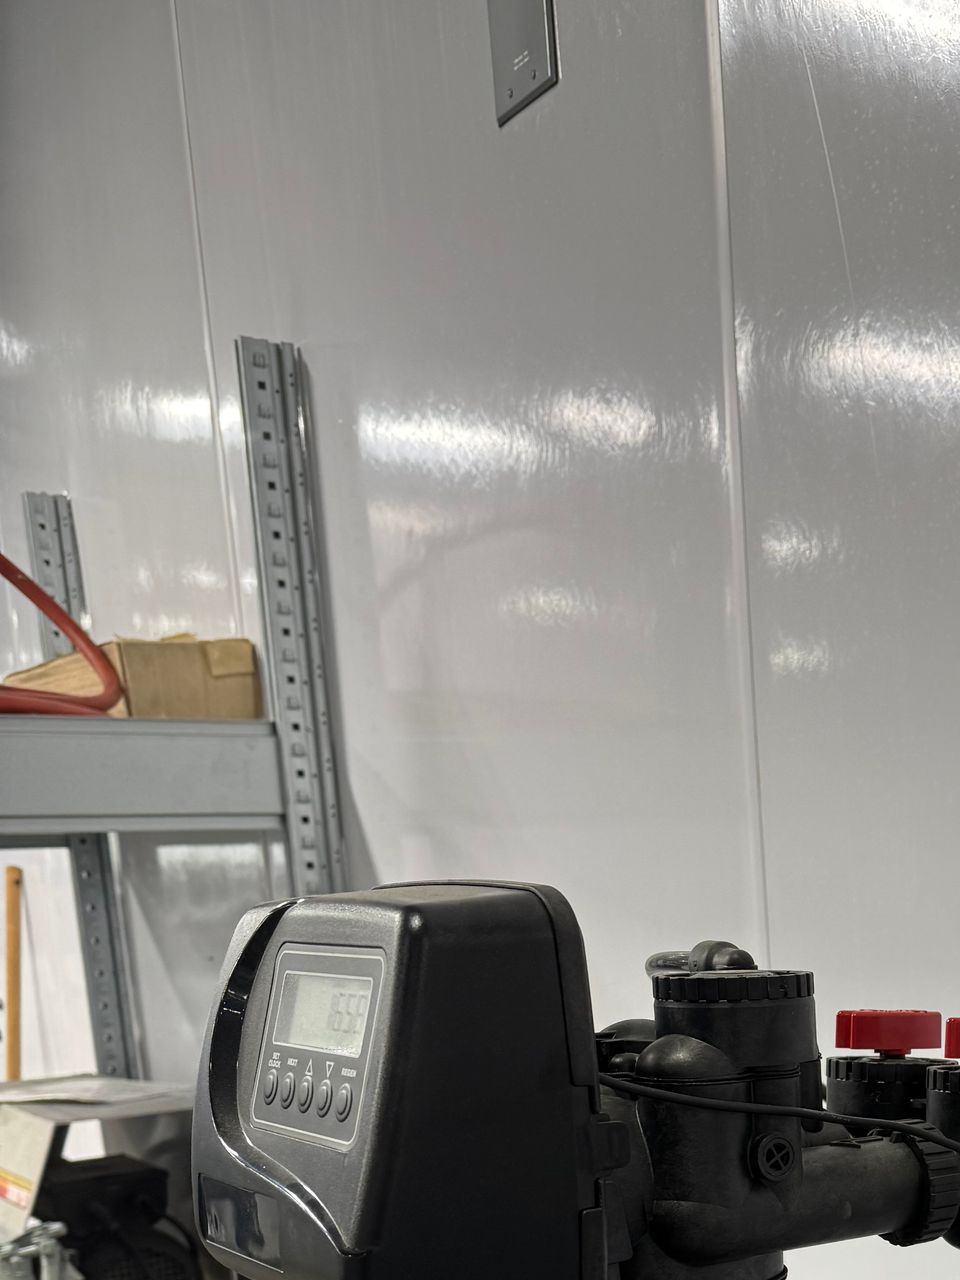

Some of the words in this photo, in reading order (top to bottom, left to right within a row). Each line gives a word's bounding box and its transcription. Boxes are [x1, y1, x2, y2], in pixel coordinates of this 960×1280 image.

[268, 1059, 281, 1068] CLOCK
[287, 1058, 298, 1066] NEXT
[341, 1067, 357, 1077] REGEN
